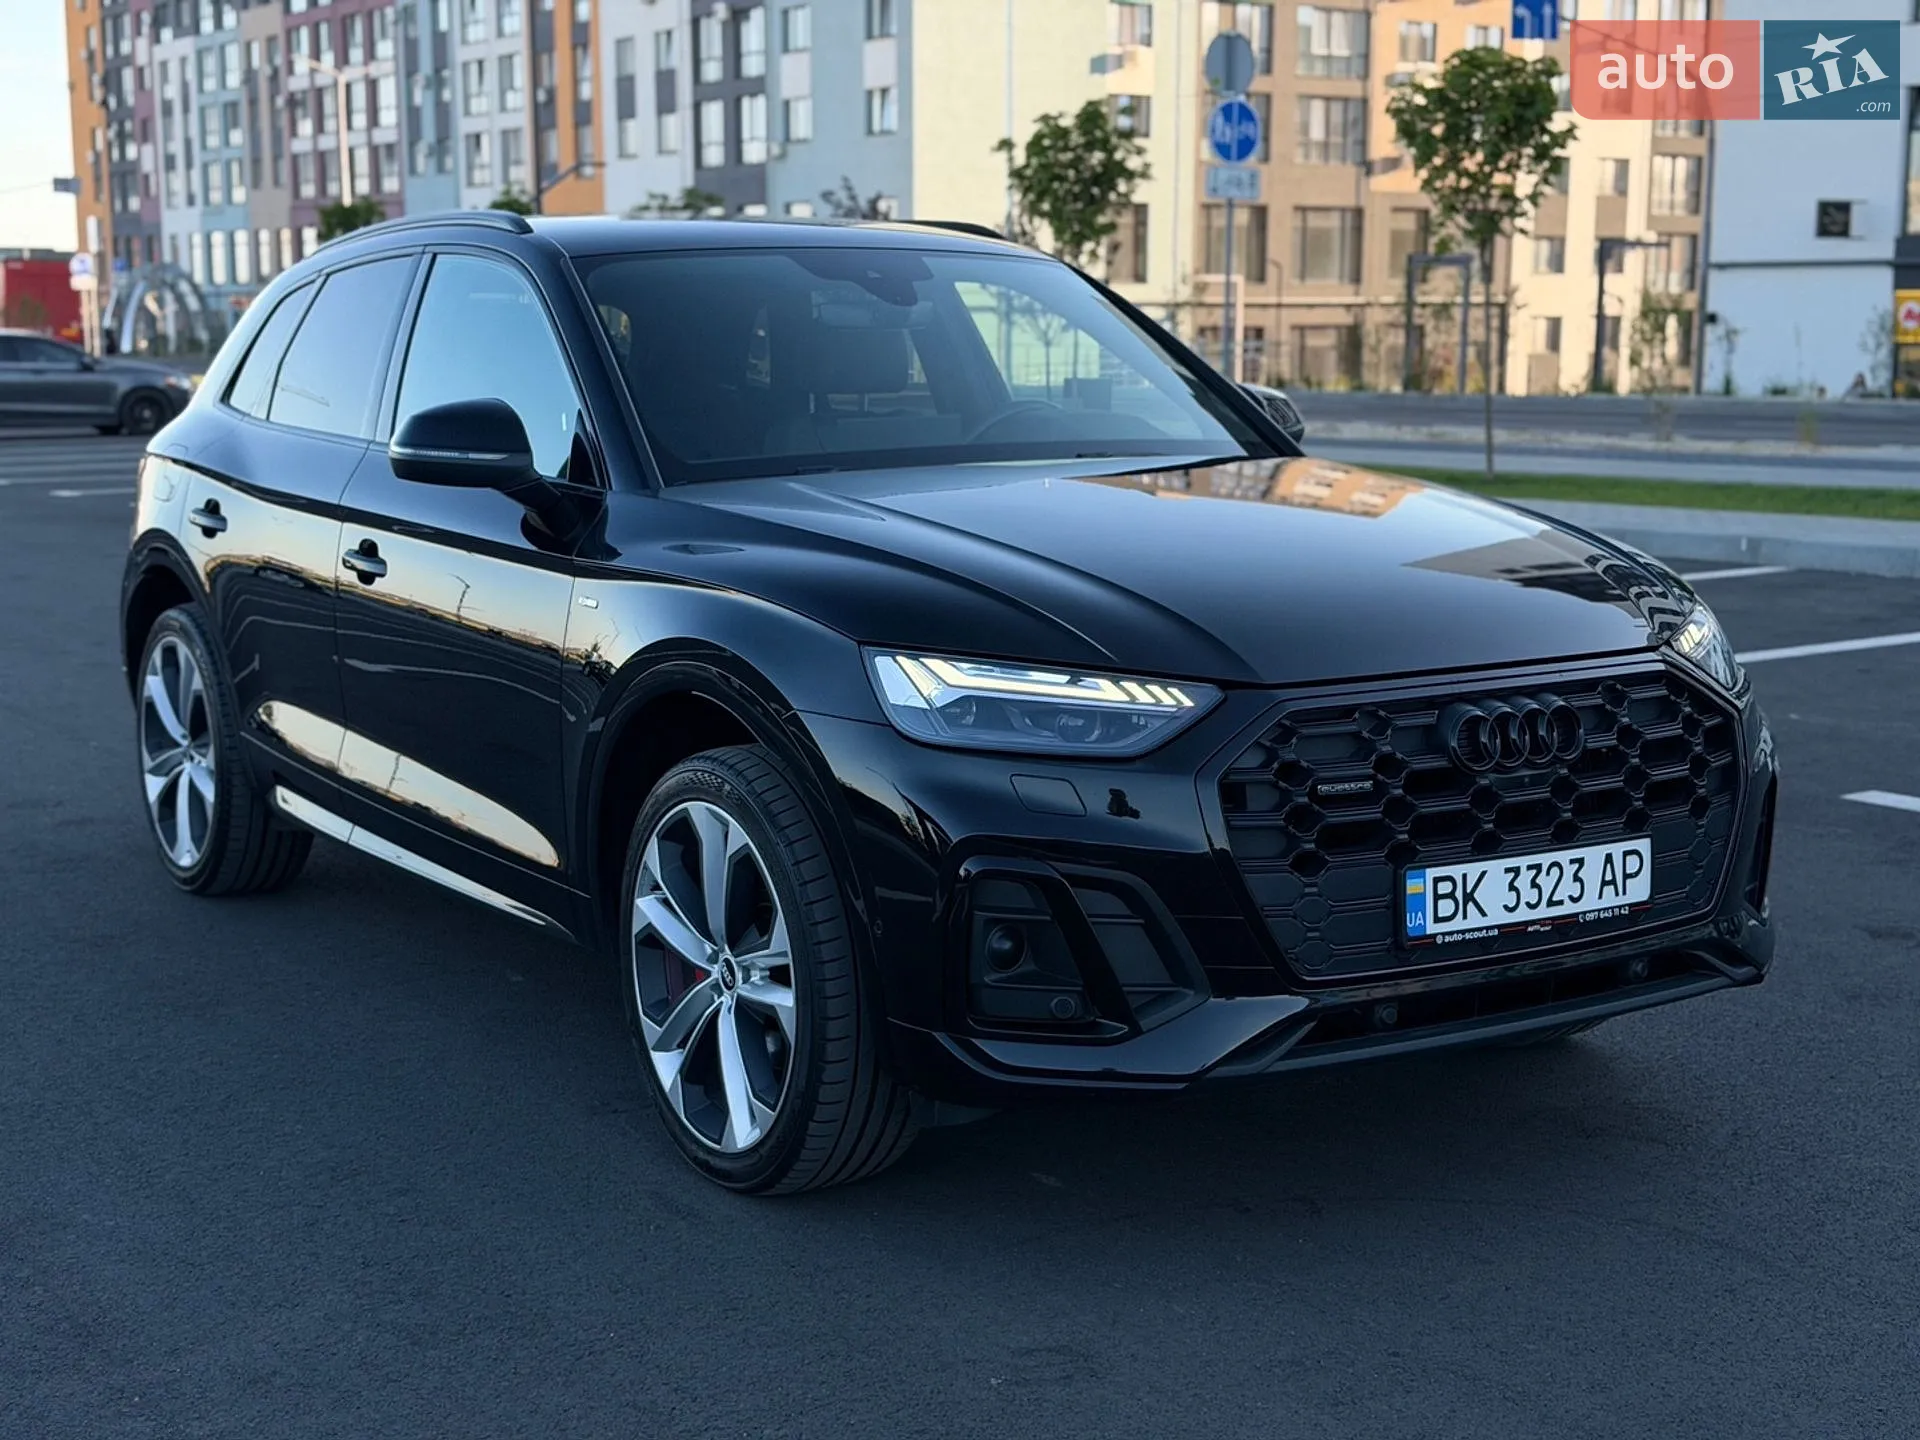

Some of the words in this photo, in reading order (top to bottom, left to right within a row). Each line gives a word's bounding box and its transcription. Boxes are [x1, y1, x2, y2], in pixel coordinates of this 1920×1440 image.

[1432, 870, 1488, 924] BK
[1502, 856, 1586, 913] 3323
[1598, 849, 1644, 900] AP
[1407, 911, 1424, 927] UA
